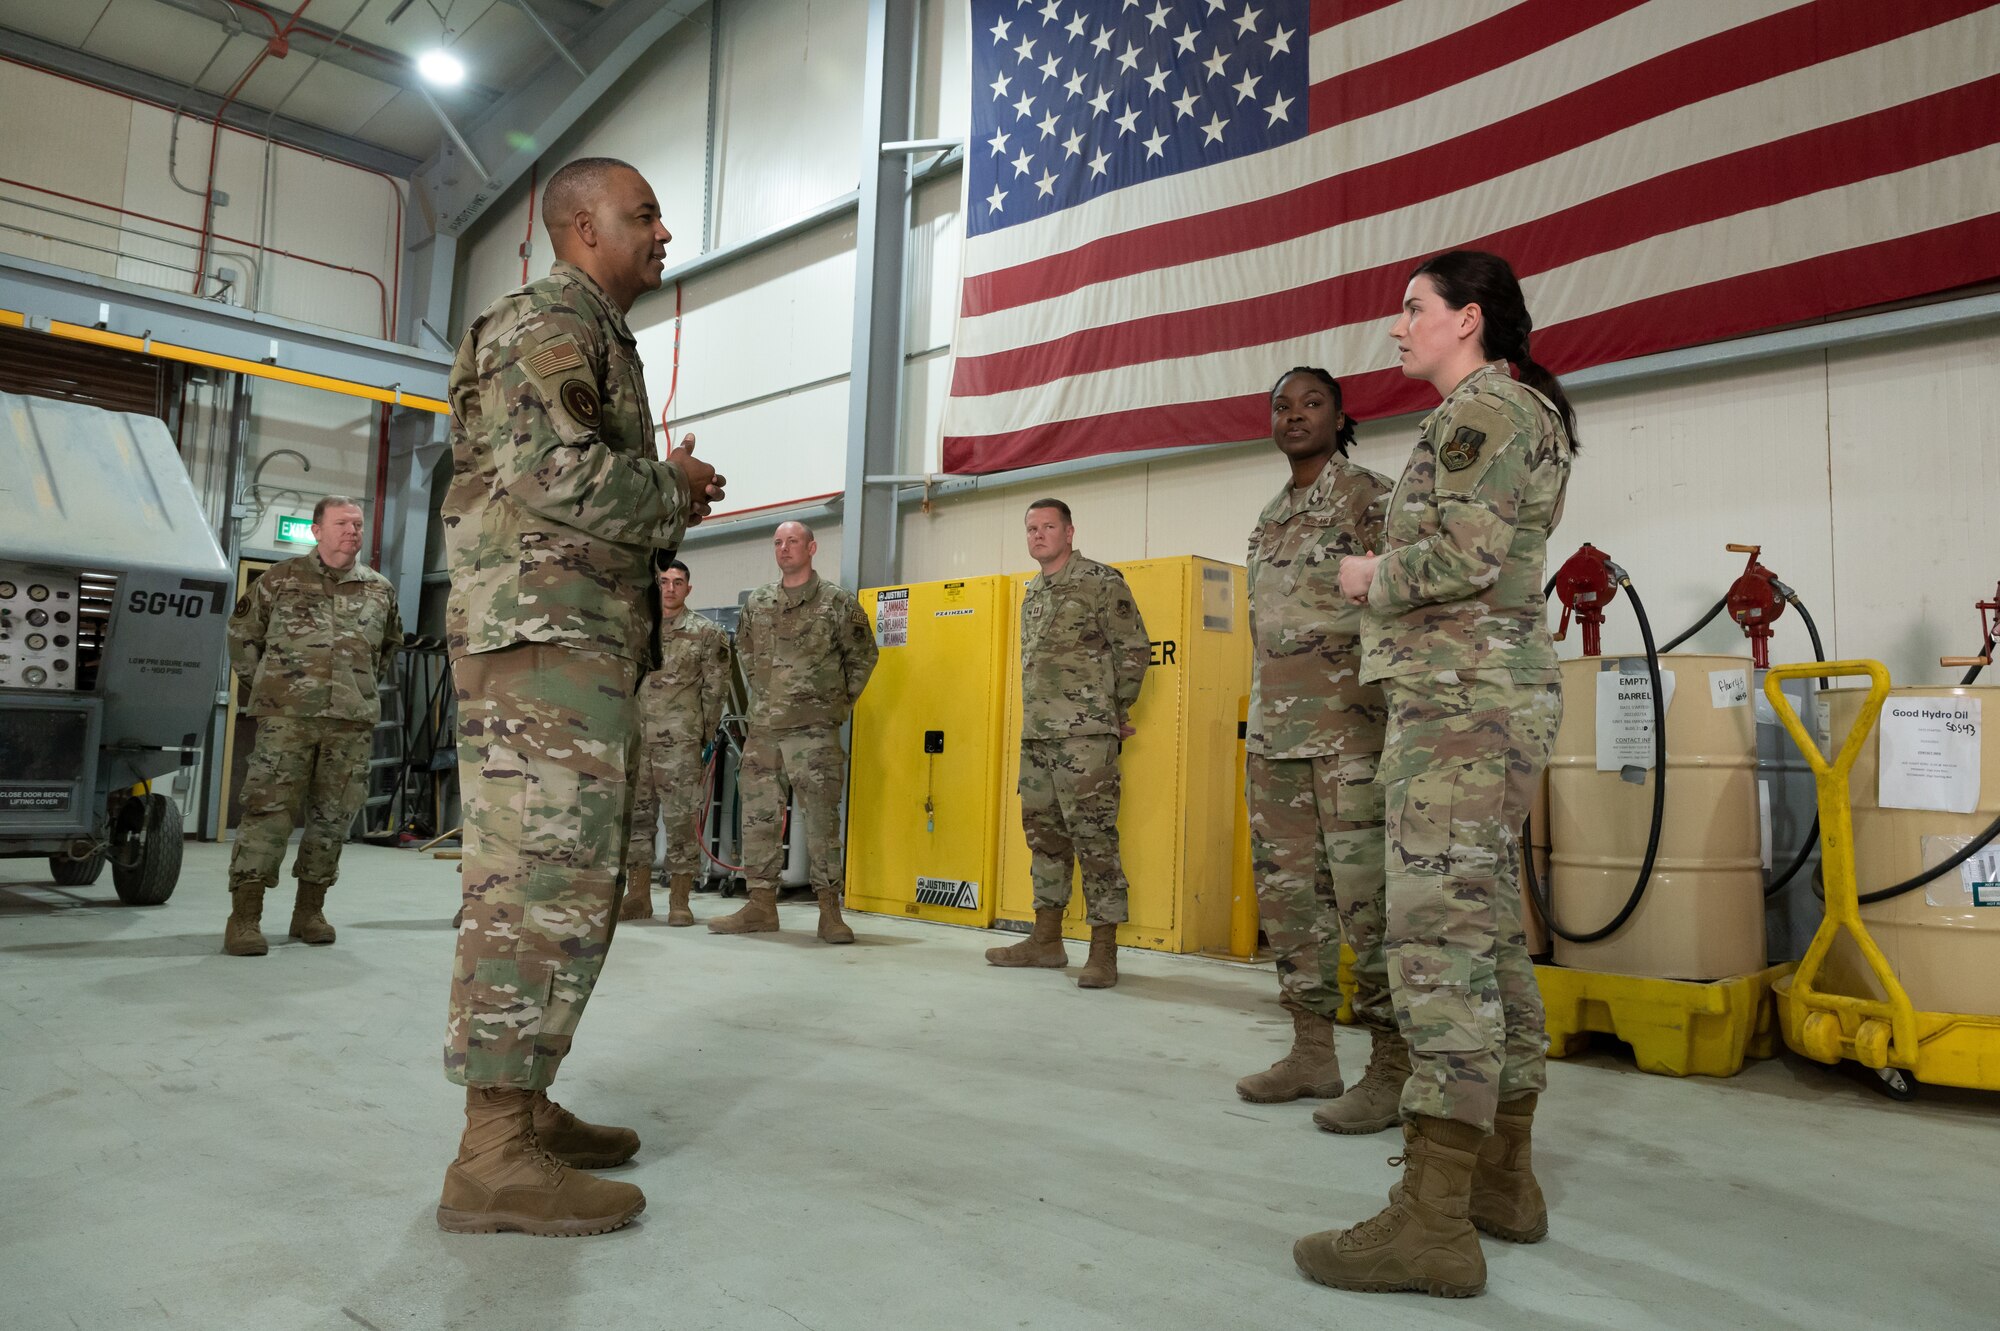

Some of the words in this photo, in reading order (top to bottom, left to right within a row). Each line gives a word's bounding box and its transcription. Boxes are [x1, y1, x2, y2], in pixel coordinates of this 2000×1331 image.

[128, 590, 204, 618] SG40
[884, 600, 908, 613] FLAMMABLE
[128, 657, 145, 665] LOW
[1619, 677, 1649, 686] EMPTY
[1618, 692, 1652, 700] BARREL
[1892, 709, 1919, 718] Good
[1922, 710, 1952, 720] Hydro
[1954, 711, 1968, 719] Oil
[1946, 722, 1976, 736] SDS43
[925, 880, 956, 892] JUSTRITE
